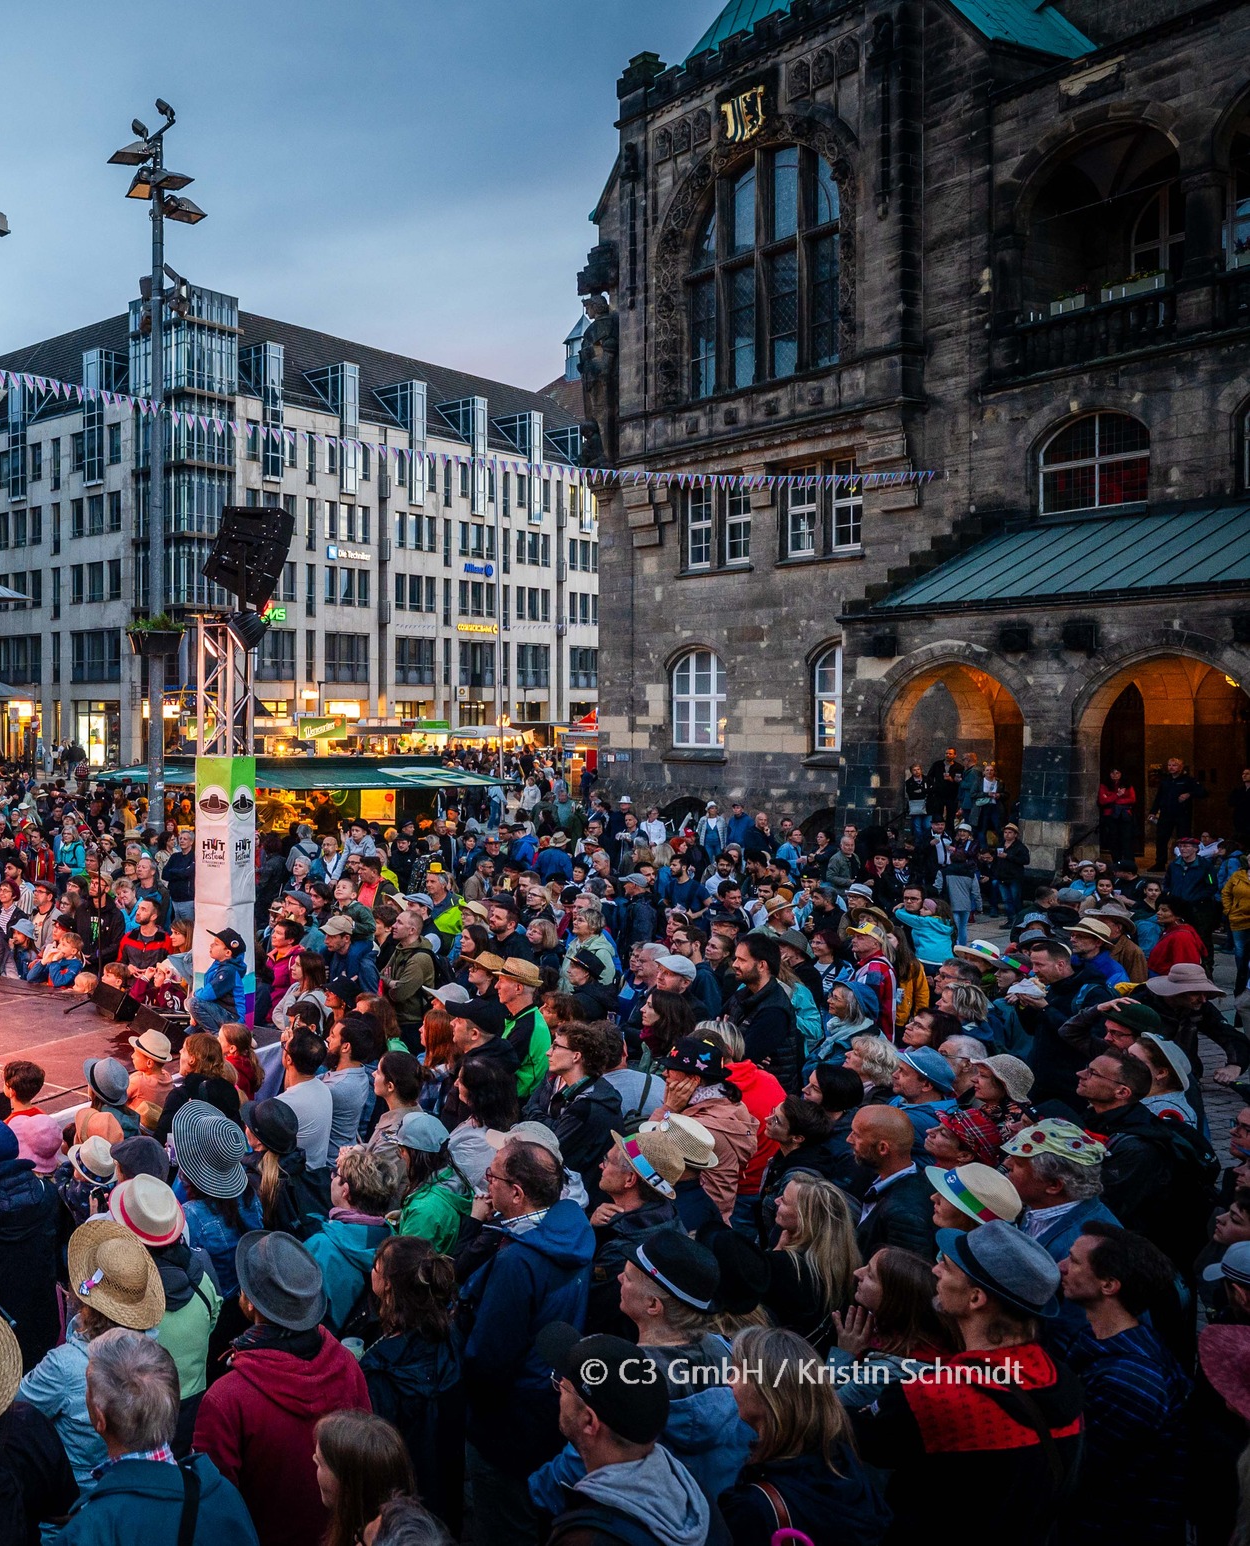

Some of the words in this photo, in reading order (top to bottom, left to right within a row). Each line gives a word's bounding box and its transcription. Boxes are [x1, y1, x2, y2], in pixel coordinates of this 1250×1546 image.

[464, 563, 484, 574] Allianz
[202, 838, 225, 850] HUT
[235, 838, 251, 851] HUT
